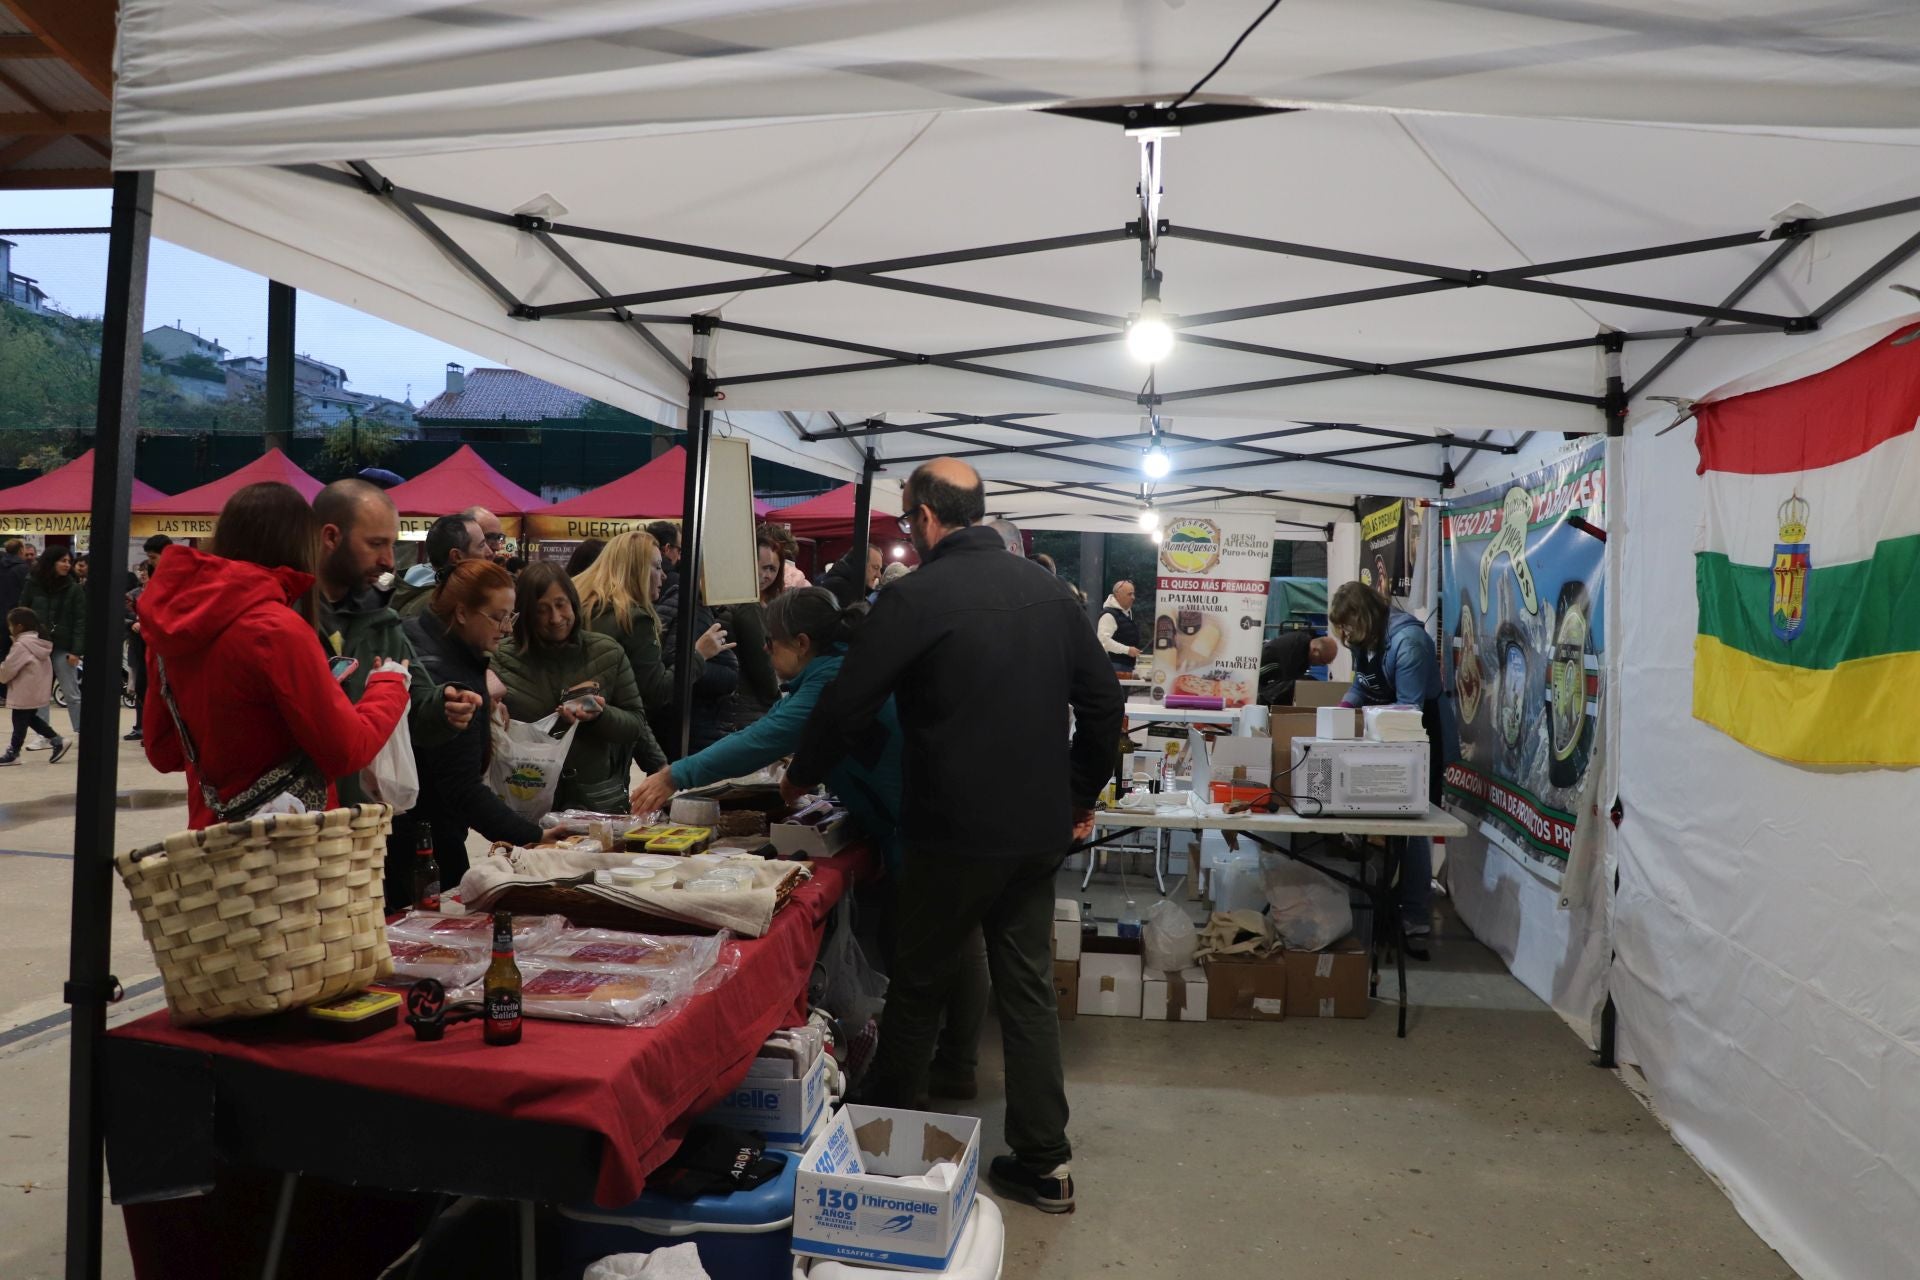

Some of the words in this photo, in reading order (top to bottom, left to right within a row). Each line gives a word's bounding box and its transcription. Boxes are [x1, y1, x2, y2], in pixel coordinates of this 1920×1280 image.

[15, 517, 33, 532] DE
[157, 519, 179, 532] LAS
[181, 520, 212, 533] TRES
[567, 520, 630, 538] PUERTO
[1449, 511, 1481, 537] UESO
[1475, 508, 1497, 534] DE
[1163, 541, 1217, 554] MonteQuesos
[1223, 538, 1269, 549] Artesano
[1222, 548, 1241, 557] Puro
[1247, 549, 1269, 559] Oveja
[1160, 579, 1169, 588] EL
[1171, 580, 1199, 589] QUESO
[1220, 581, 1265, 592] PREMIADO
[1168, 593, 1218, 604] PATAMULO
[1185, 604, 1228, 613] VILLANUBLA
[1488, 785, 1507, 810] VENTA
[1507, 794, 1518, 816] DE
[491, 1003, 519, 1012] Estrella
[491, 1011, 518, 1020] Galicia
[816, 1187, 858, 1211] 130
[862, 1193, 938, 1215] l'hirondelle
[821, 1208, 851, 1220] AÑOS
[836, 1247, 875, 1258] LESAFFRE
